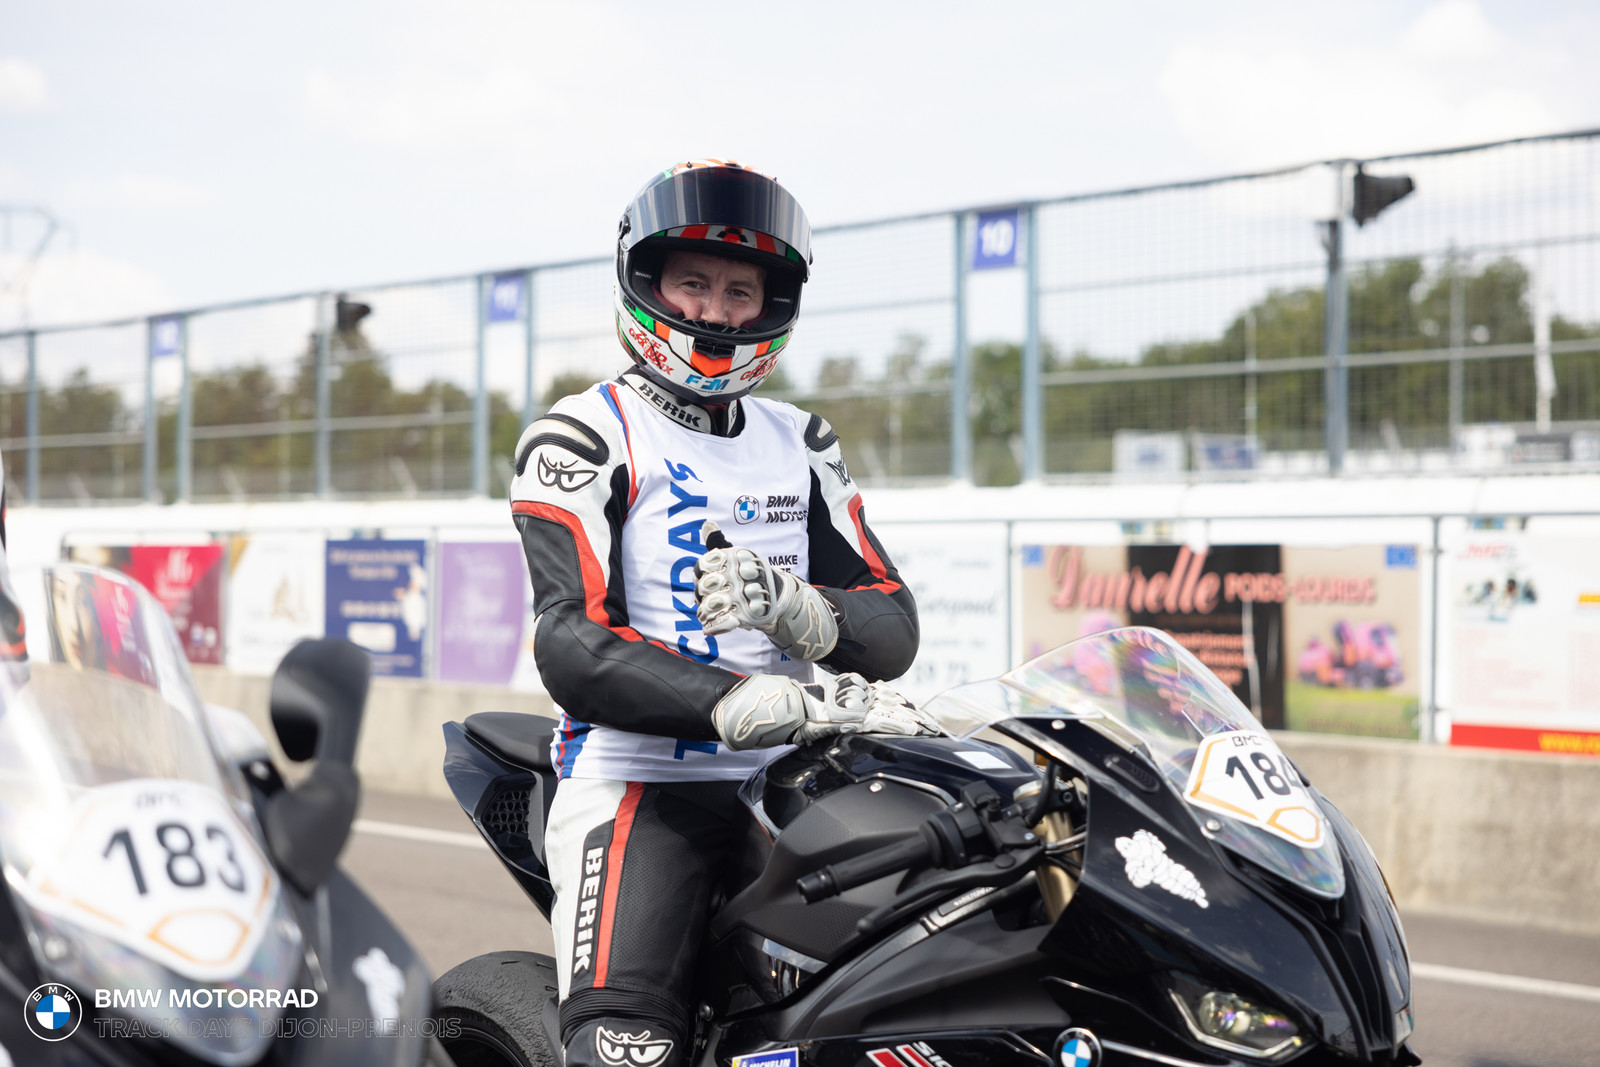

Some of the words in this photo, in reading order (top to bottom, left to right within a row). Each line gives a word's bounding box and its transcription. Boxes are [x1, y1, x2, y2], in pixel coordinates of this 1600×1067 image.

[766, 496, 799, 508] BMW
[768, 555, 798, 566] MAKE
[664, 457, 719, 760] TCKDAYS
[102, 821, 246, 895] 183
